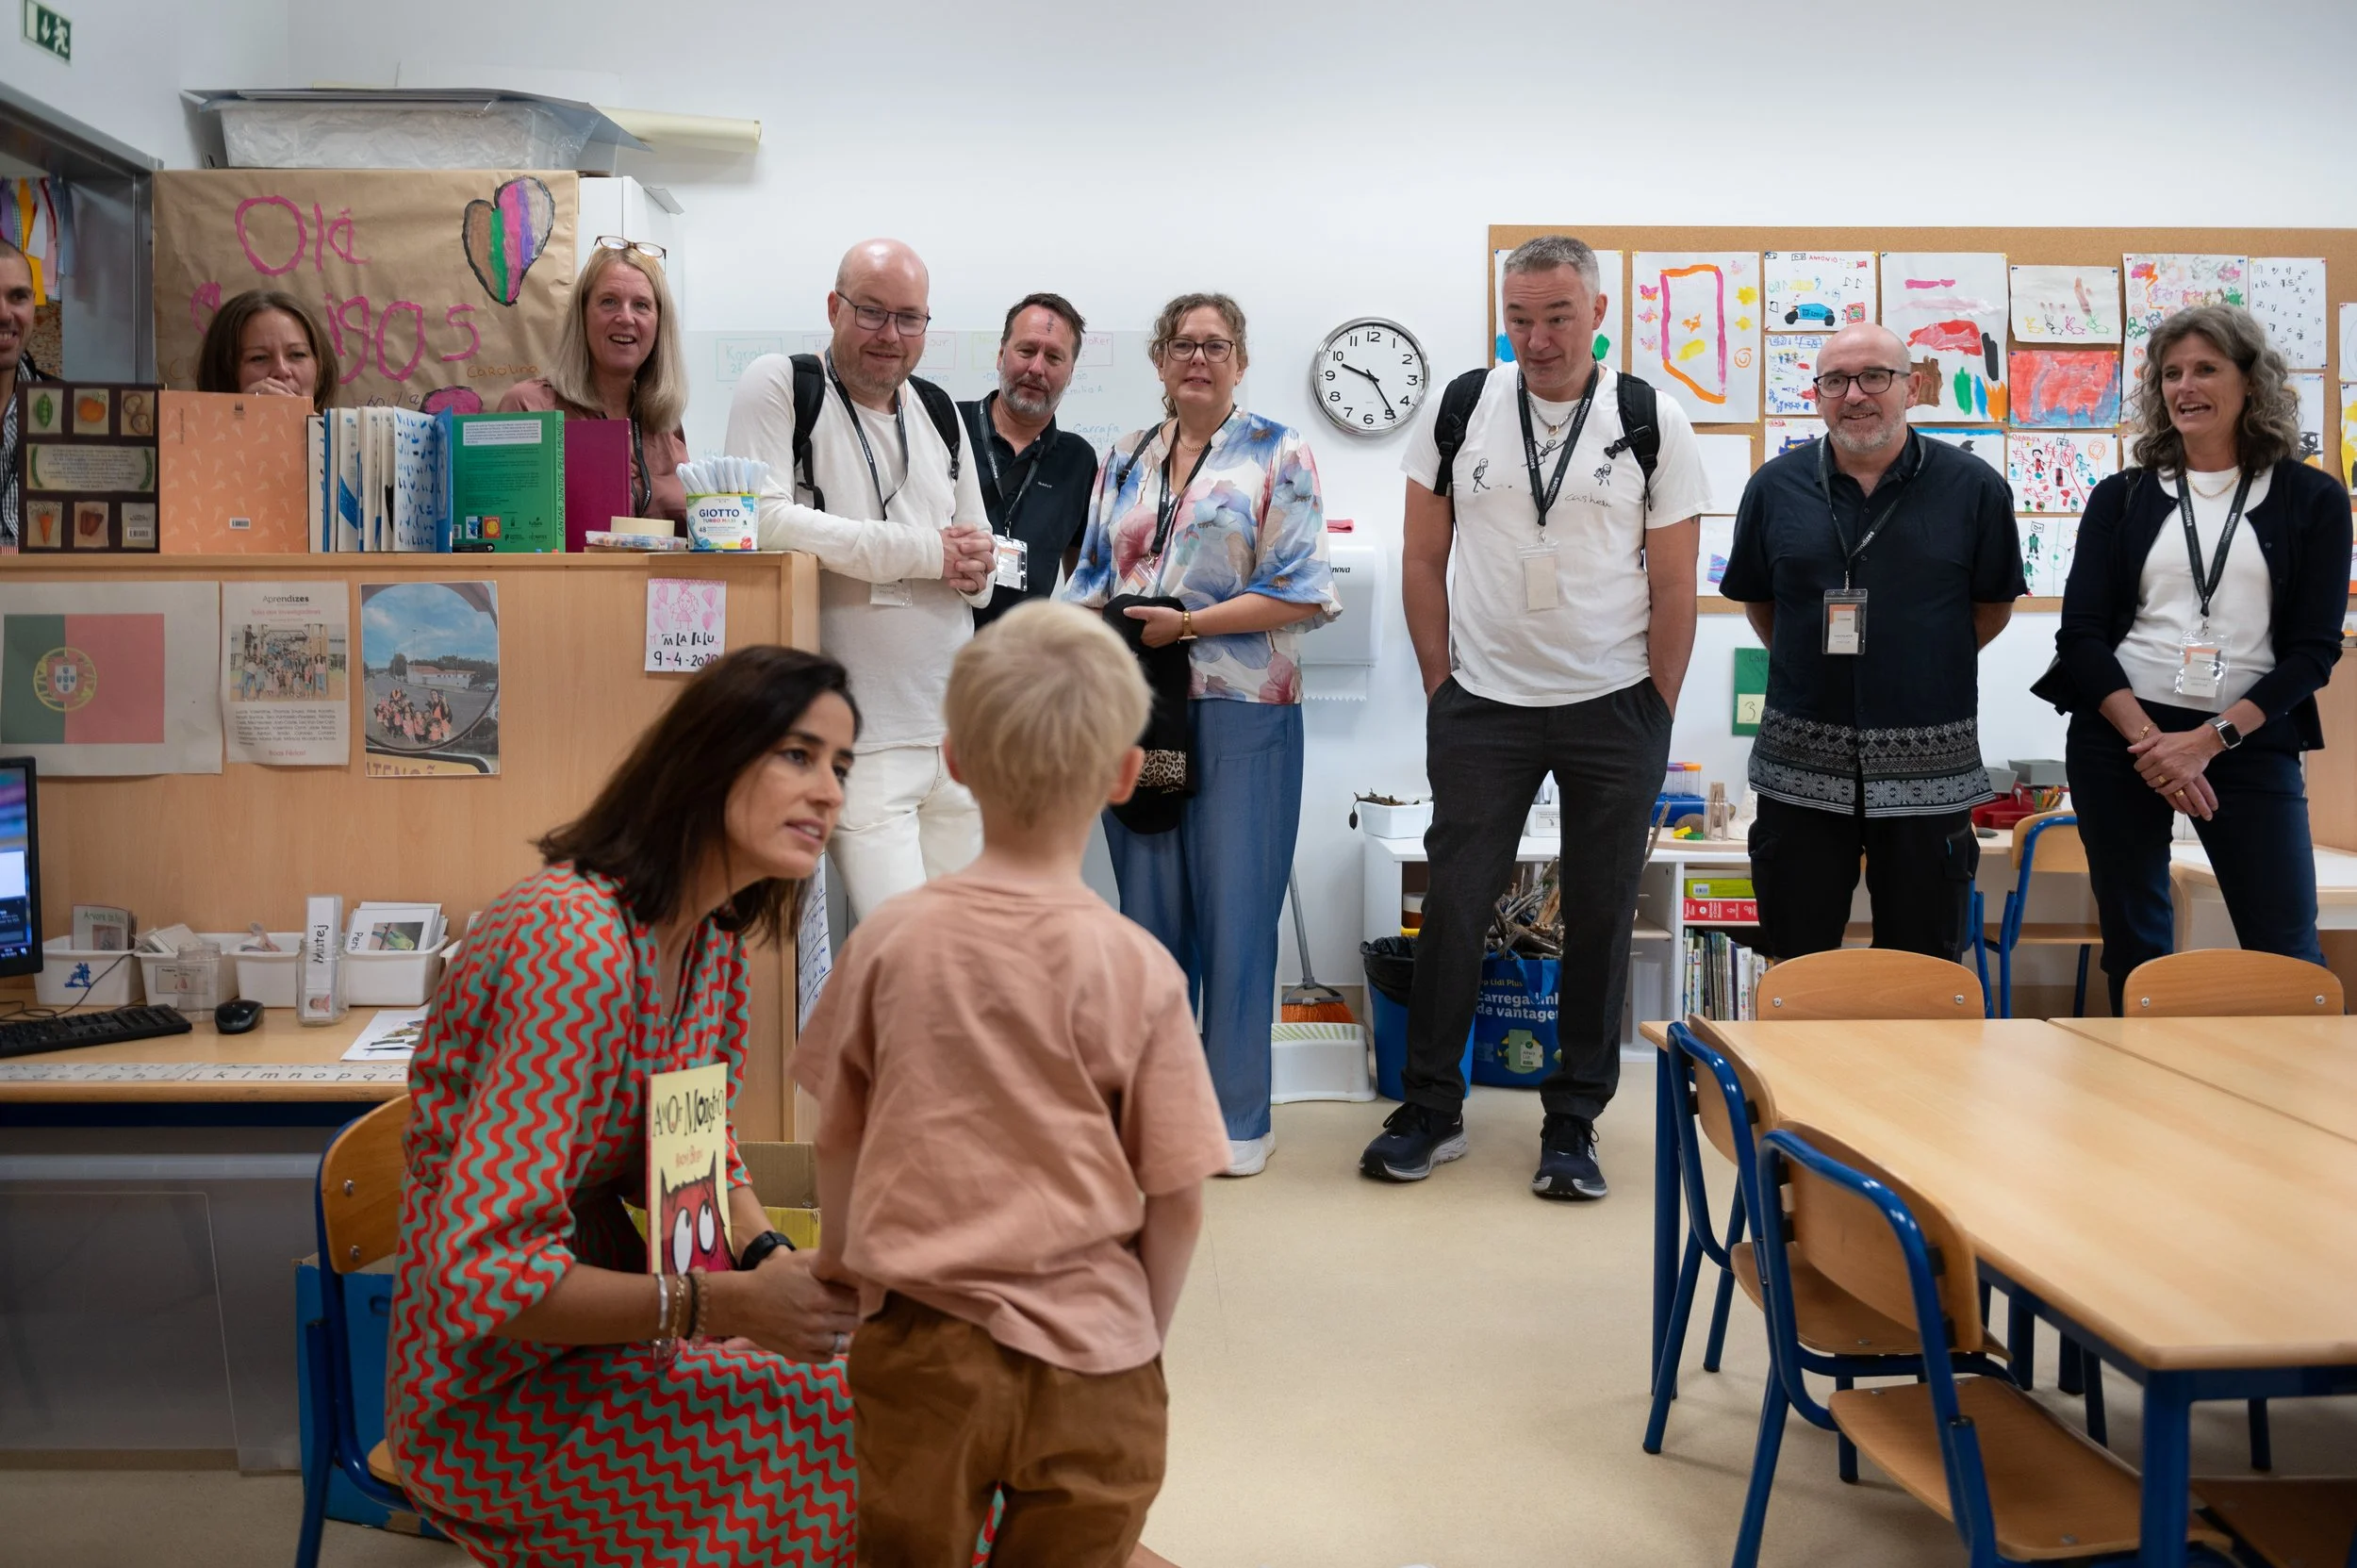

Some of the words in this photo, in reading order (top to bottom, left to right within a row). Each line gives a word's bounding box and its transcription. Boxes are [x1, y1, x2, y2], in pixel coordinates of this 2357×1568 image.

[235, 195, 371, 275] Olá
[1349, 336, 1358, 347] 11
[1366, 331, 1381, 342] 12
[1393, 338, 1396, 349] 1
[1332, 351, 1344, 361] 10
[1402, 354, 1413, 365] 2
[1325, 370, 1336, 381] 9
[1406, 374, 1418, 386] 3
[1328, 391, 1341, 402] 8
[1399, 395, 1410, 406] 4
[1343, 406, 1353, 418] 7
[1384, 409, 1394, 421] 5
[1363, 414, 1374, 425] 6
[699, 509, 740, 518] GIOTTO
[262, 595, 310, 603] Aprendizes
[1744, 701, 1755, 721] 3
[1507, 979, 1524, 987] Plus
[1476, 1003, 1493, 1015] de
